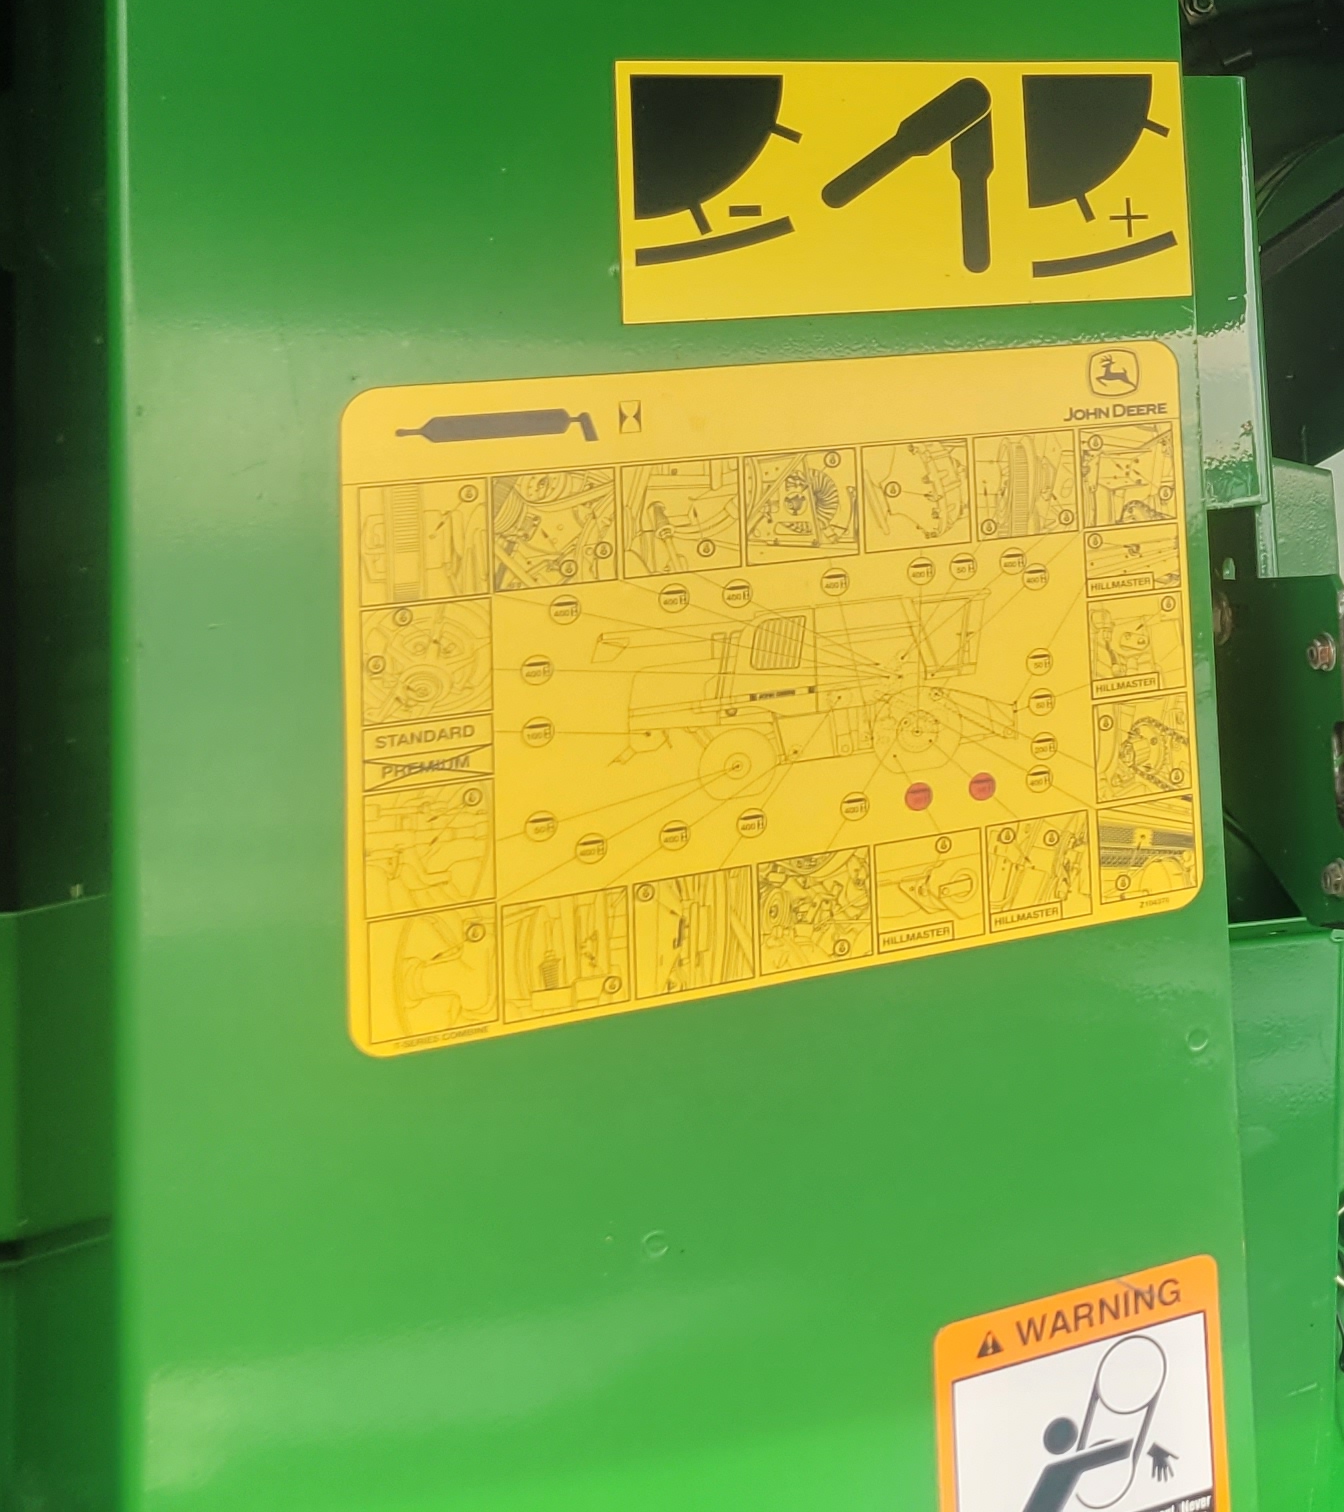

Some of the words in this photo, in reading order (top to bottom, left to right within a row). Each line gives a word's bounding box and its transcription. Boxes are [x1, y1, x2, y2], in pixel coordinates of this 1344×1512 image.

[1063, 407, 1110, 422] JOHN
[1112, 402, 1168, 418] DEERE
[1090, 576, 1152, 592] HILLMASTER
[1095, 676, 1156, 694] HILLMASTER
[374, 724, 476, 750] STANDARD
[381, 755, 471, 780] PREMIUM
[993, 906, 1060, 928] HILLMASTER
[882, 926, 951, 947] HILLMASTER
[1015, 1277, 1182, 1347] WARNING
